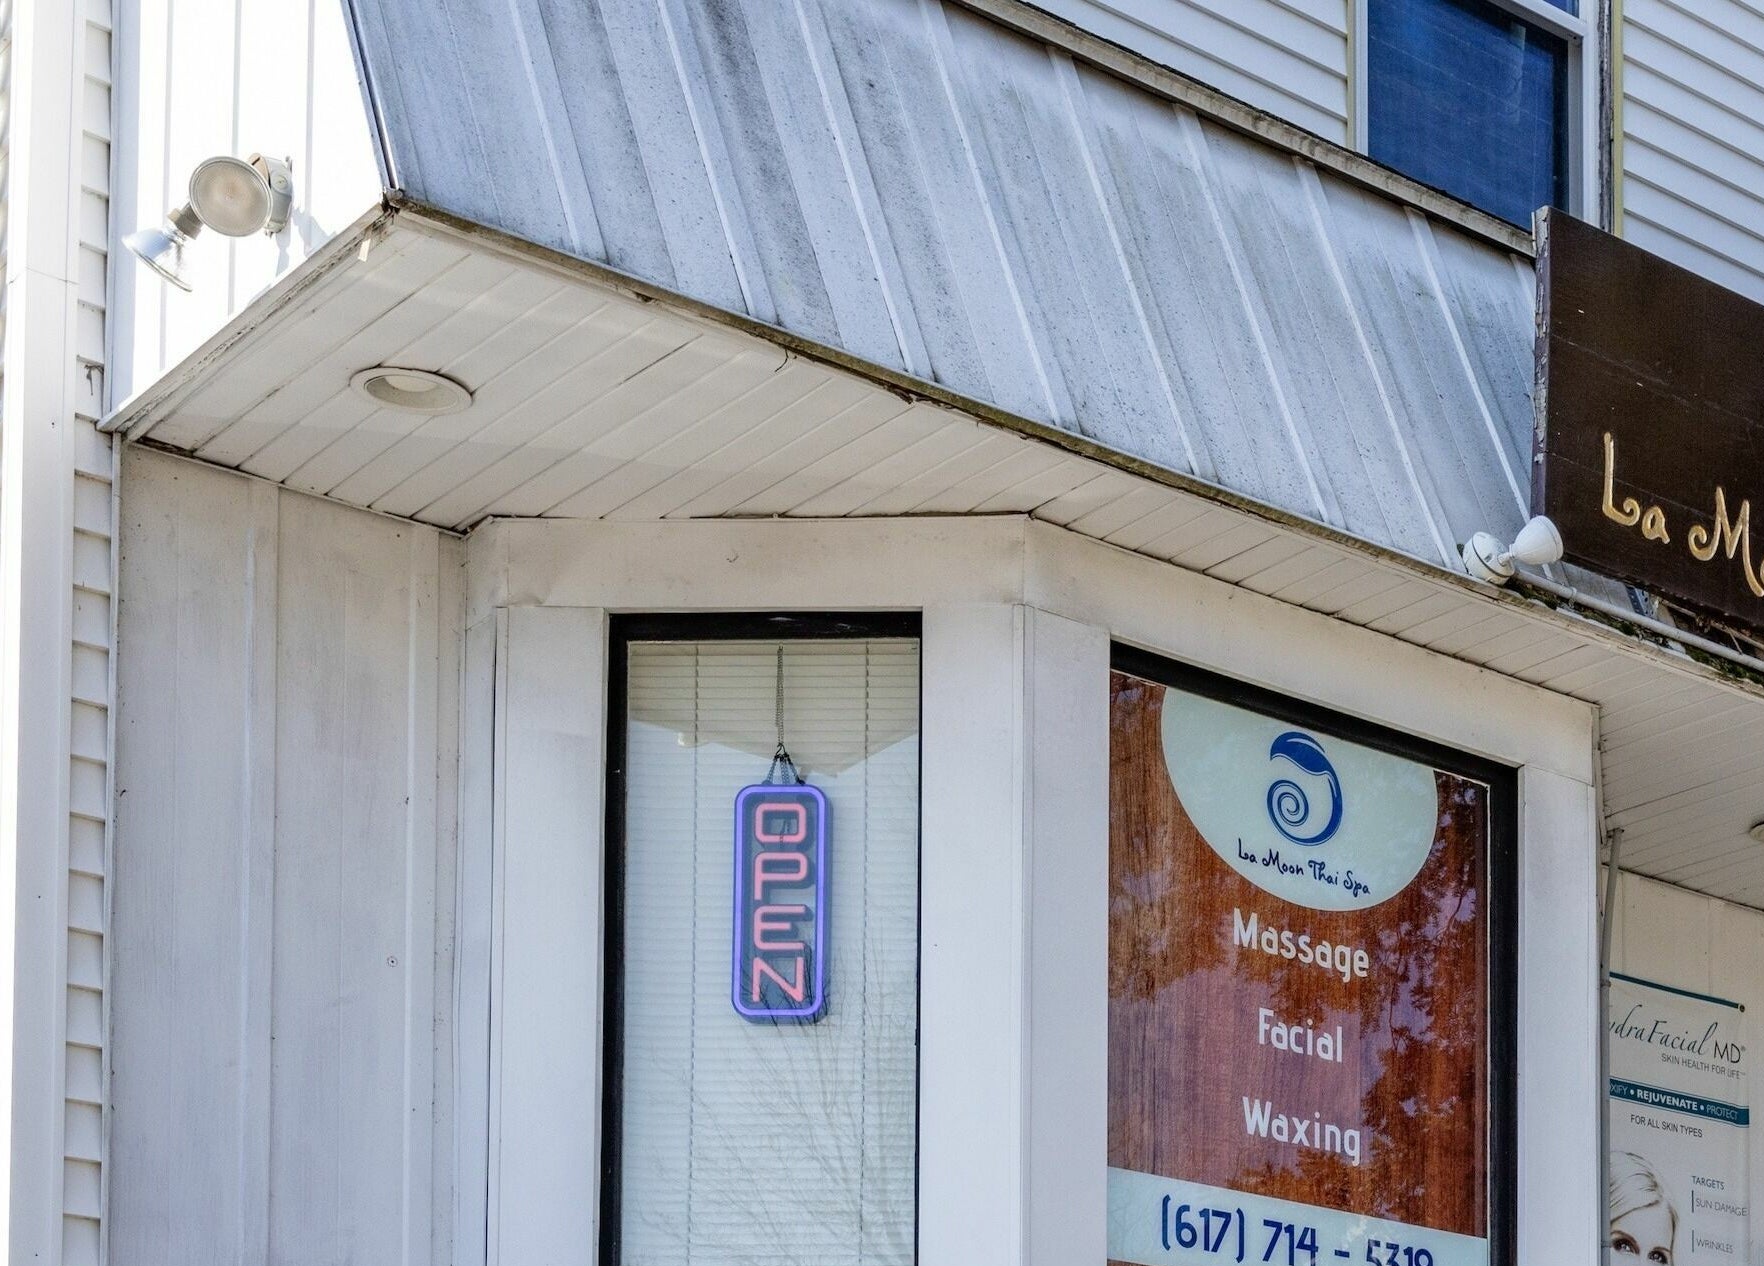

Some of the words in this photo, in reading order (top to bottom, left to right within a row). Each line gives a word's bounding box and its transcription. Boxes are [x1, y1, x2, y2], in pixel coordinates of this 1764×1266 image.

[1602, 432, 1669, 544] La
[1238, 837, 1258, 864] La
[1262, 849, 1304, 875] Moon
[1308, 860, 1339, 886] Thai
[1343, 870, 1371, 898] Spa
[751, 802, 809, 1003] OPEN
[1233, 907, 1370, 983] Massage
[1258, 1007, 1343, 1063] Facial
[1609, 1004, 1718, 1056] ydraFacial
[1661, 1053, 1680, 1065] SKIN
[1682, 1058, 1710, 1072] HEALTH
[1711, 1064, 1726, 1075] FOR
[1610, 1082, 1628, 1096] XIFY
[1637, 1088, 1698, 1111] REJUVENATE
[1706, 1103, 1738, 1121] PROTECT
[1630, 1114, 1646, 1127] FOR
[1647, 1118, 1660, 1129] ALL
[1661, 1121, 1679, 1133] SKIN
[1680, 1125, 1703, 1138] TYPES
[1242, 1096, 1361, 1166] Waxing
[1691, 1175, 1725, 1191] TARGETS
[1695, 1198, 1713, 1209] SUN
[1714, 1202, 1748, 1217] DAMAGE
[1161, 1194, 1245, 1264] (617)
[1333, 1248, 1350, 1259] -
[1696, 1238, 1734, 1254] WRINKLES
